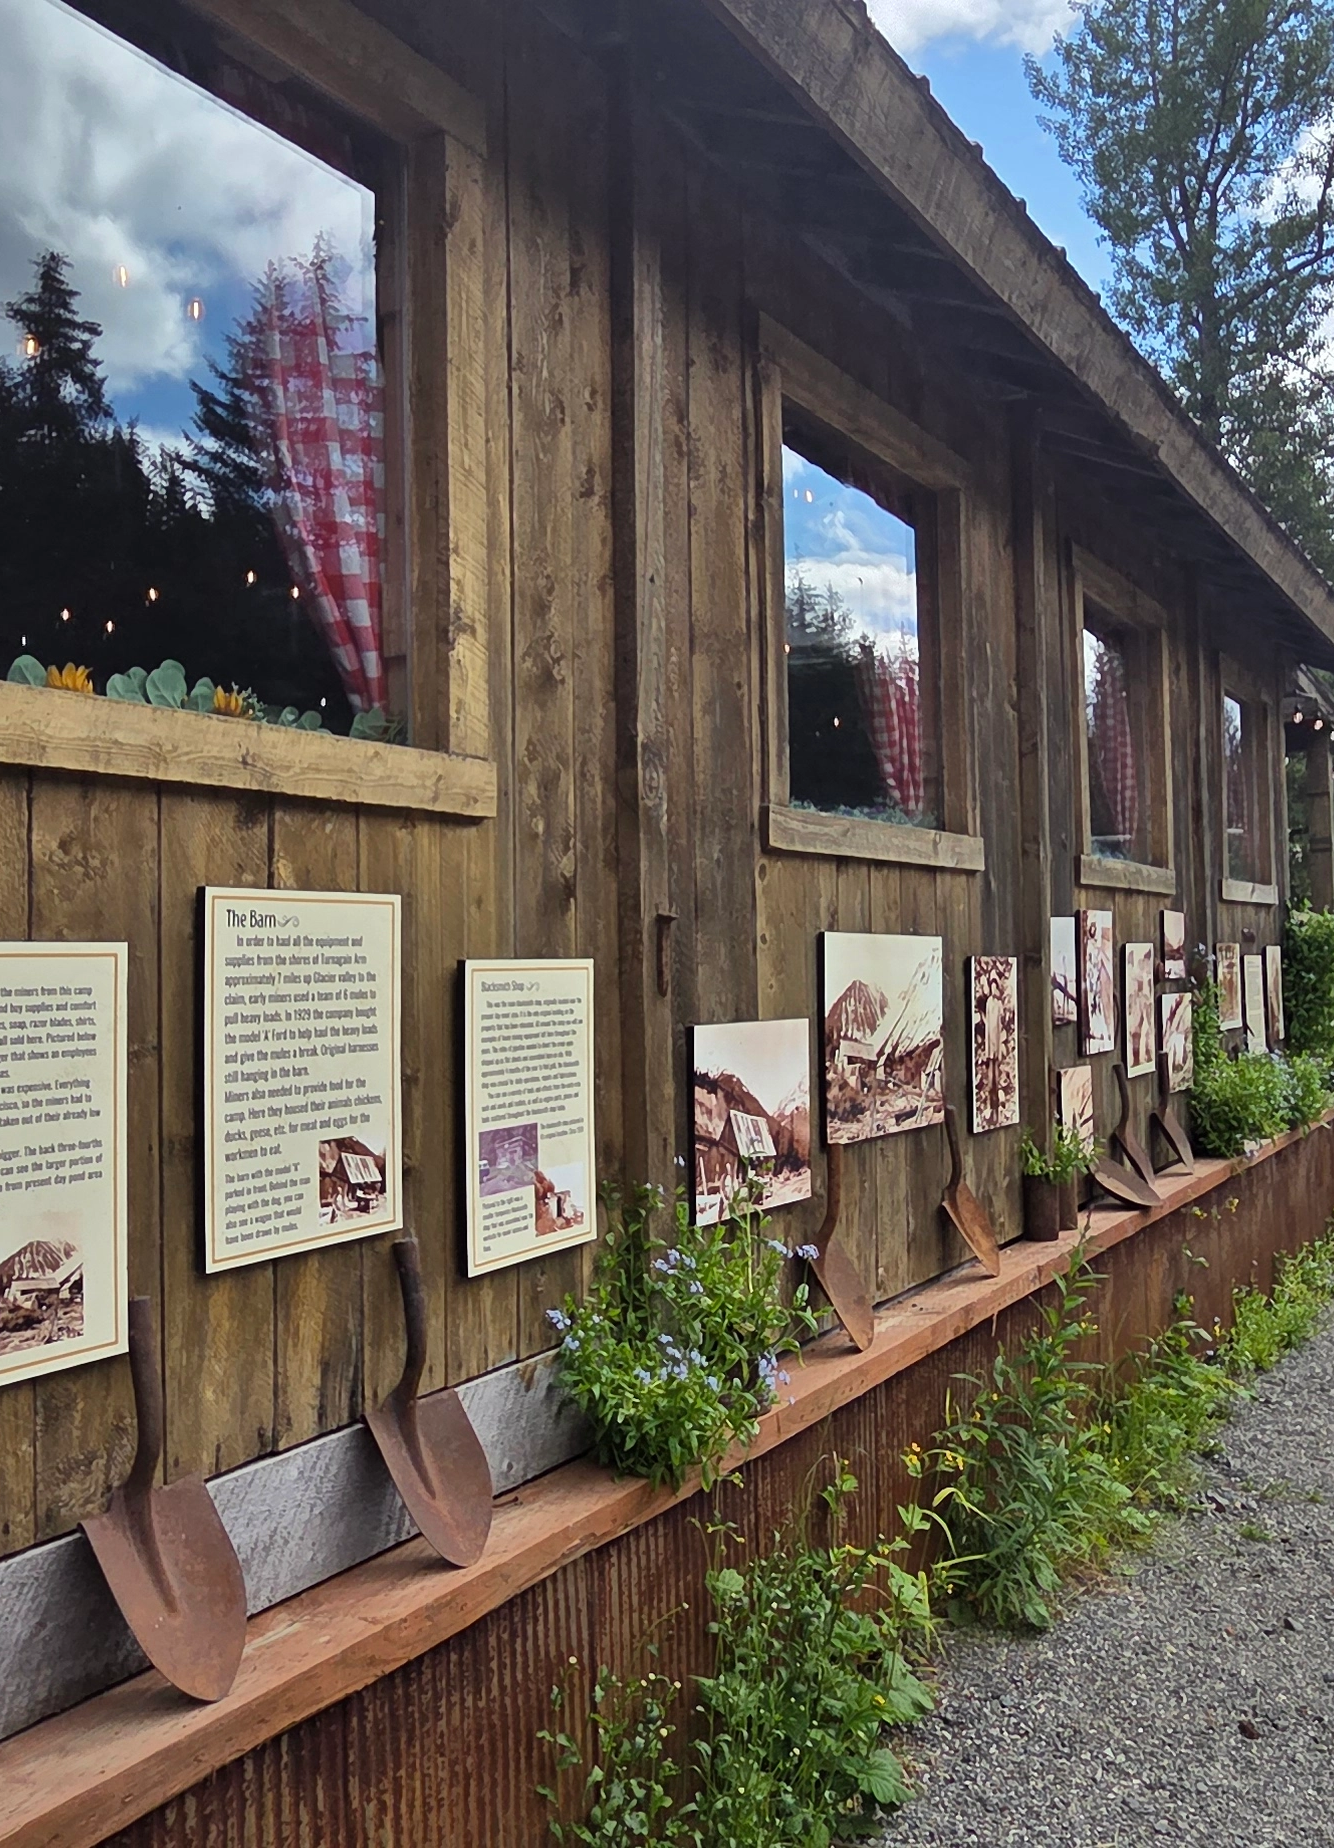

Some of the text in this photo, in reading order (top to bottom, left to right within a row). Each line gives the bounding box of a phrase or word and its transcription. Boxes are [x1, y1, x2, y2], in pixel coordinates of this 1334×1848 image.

[226, 908, 276, 928] The Barn
[239, 1011, 261, 1025] heavy
[312, 1008, 324, 1020] the
[23, 1145, 36, 1156] The
[38, 1143, 55, 1155] back
